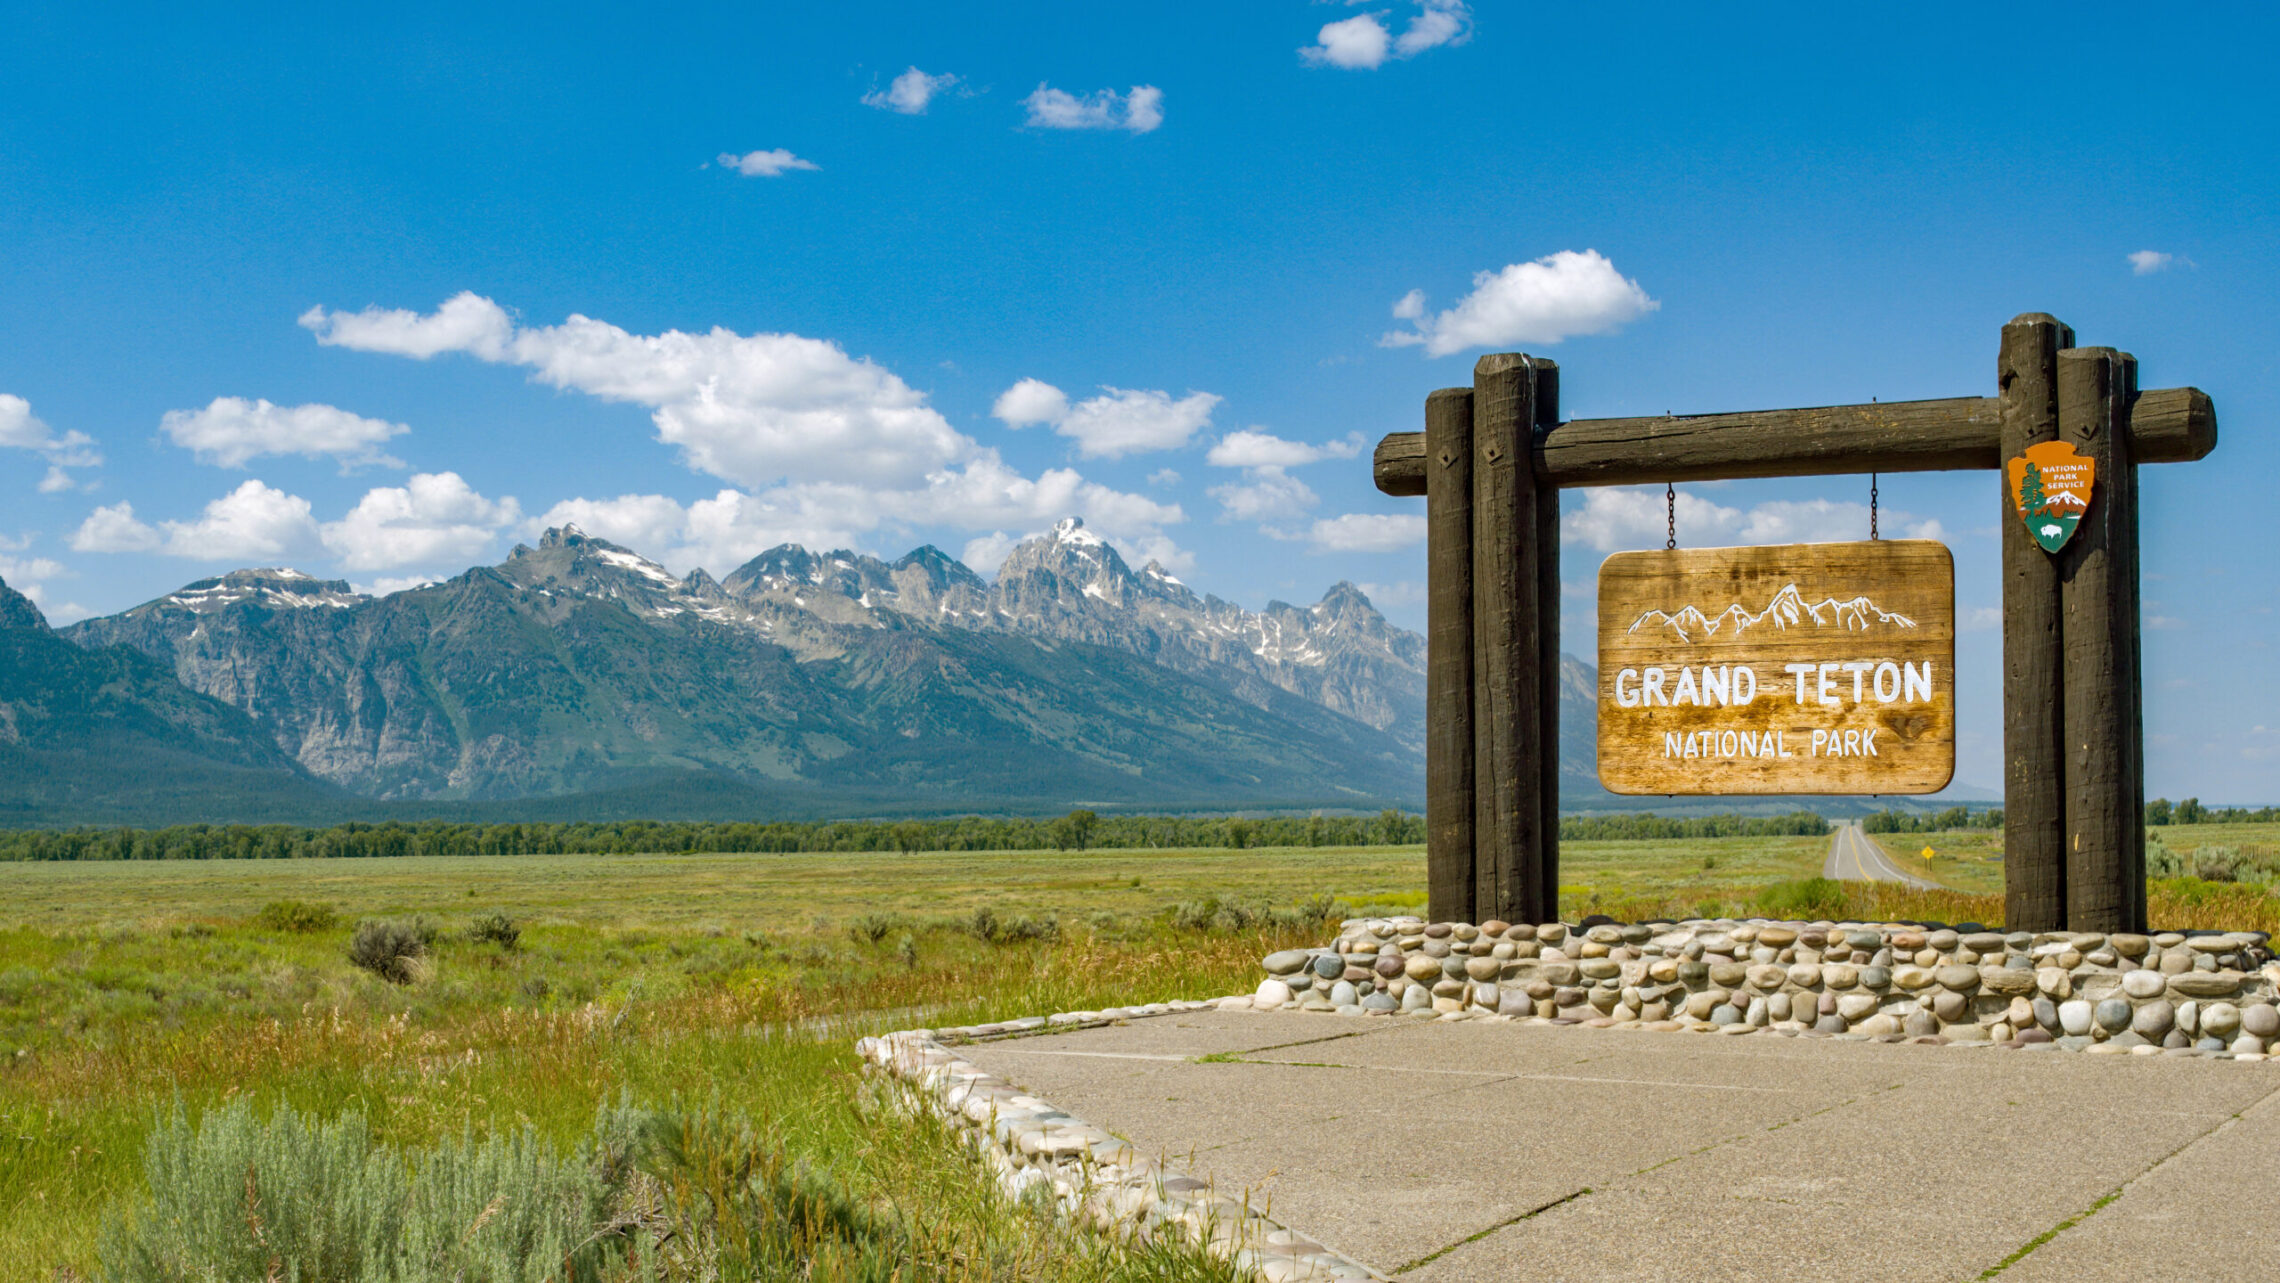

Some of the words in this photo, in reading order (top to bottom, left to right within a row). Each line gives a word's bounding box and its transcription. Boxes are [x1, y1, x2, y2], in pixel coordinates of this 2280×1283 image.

[2042, 464, 2088, 473] NATIONAL
[2047, 481, 2084, 489] SERVICE
[1615, 665, 1756, 708] GRAND
[1784, 661, 1932, 705] TETON
[1665, 730, 1792, 759] NATIONAL
[1812, 729, 1878, 757] PARK
